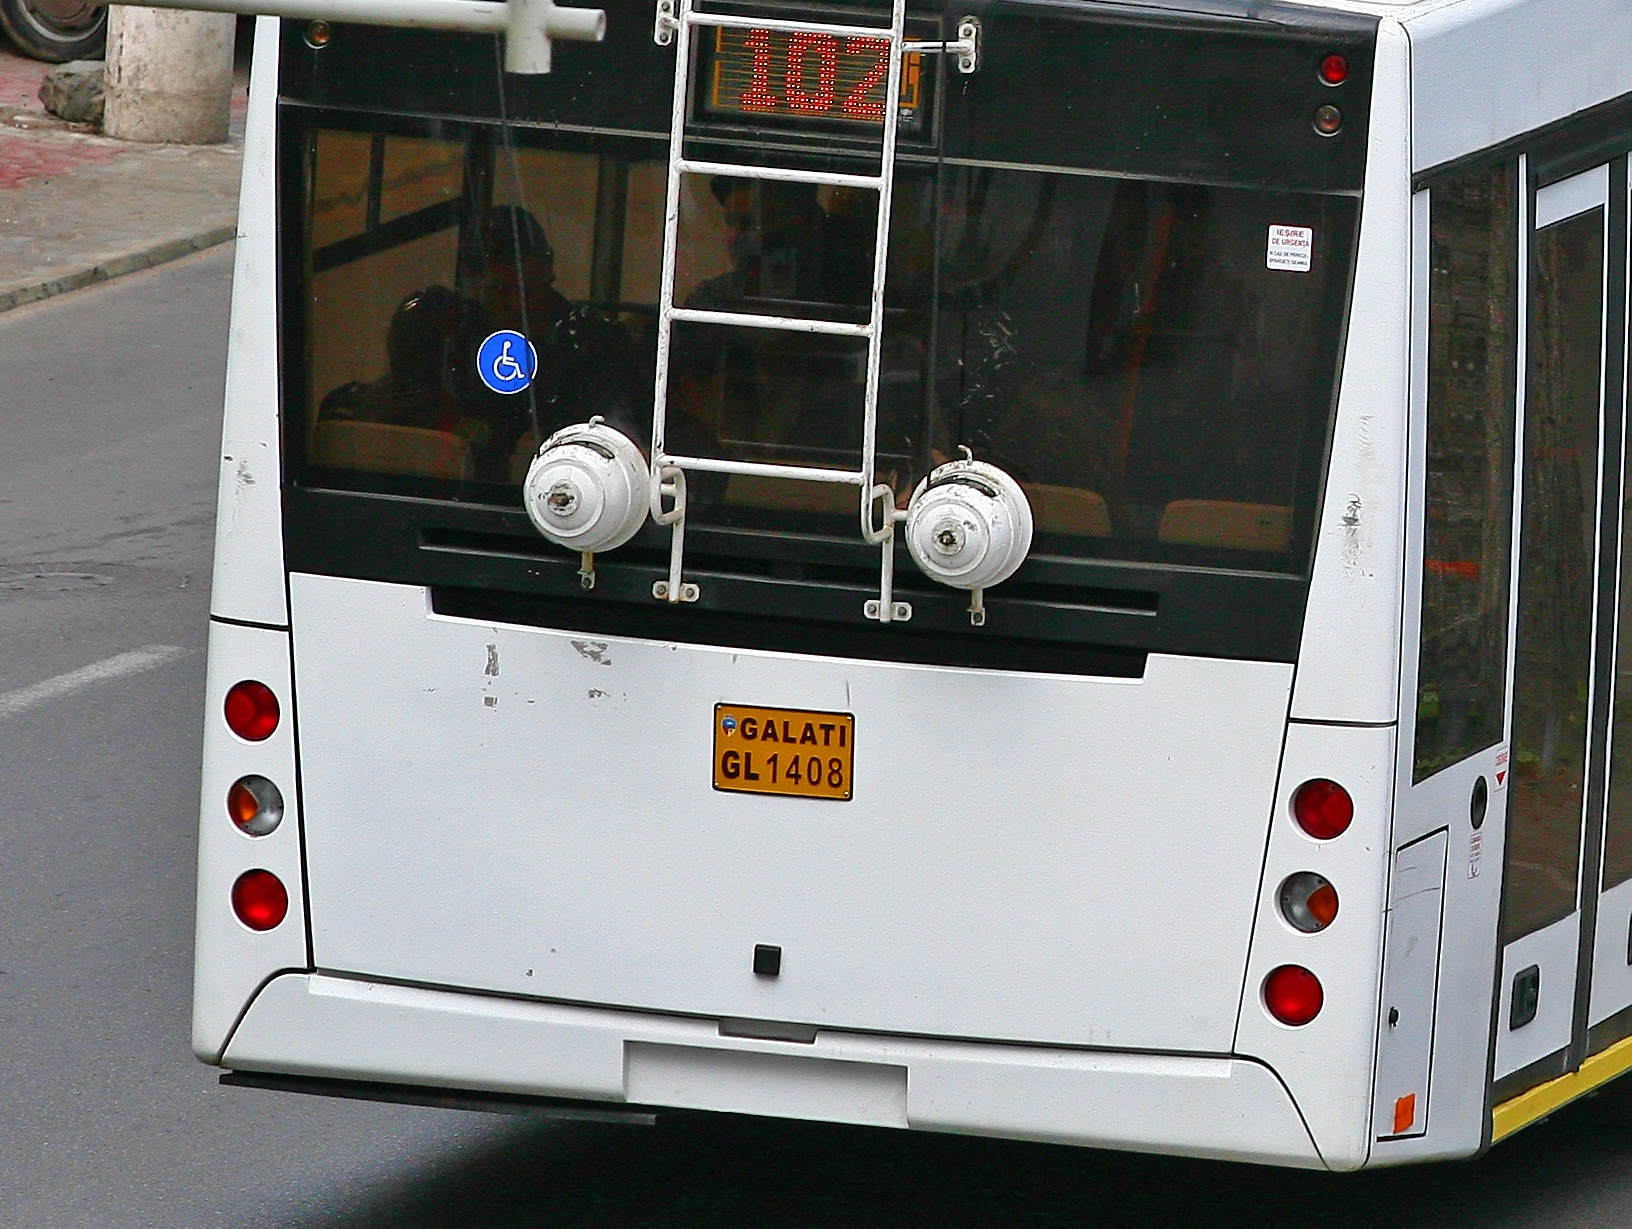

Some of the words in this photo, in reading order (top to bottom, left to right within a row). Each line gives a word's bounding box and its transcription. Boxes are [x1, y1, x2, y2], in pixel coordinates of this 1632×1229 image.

[741, 28, 890, 121] 102
[740, 717, 847, 748] GALATI
[721, 750, 760, 781] GL
[766, 752, 844, 789] 1408
